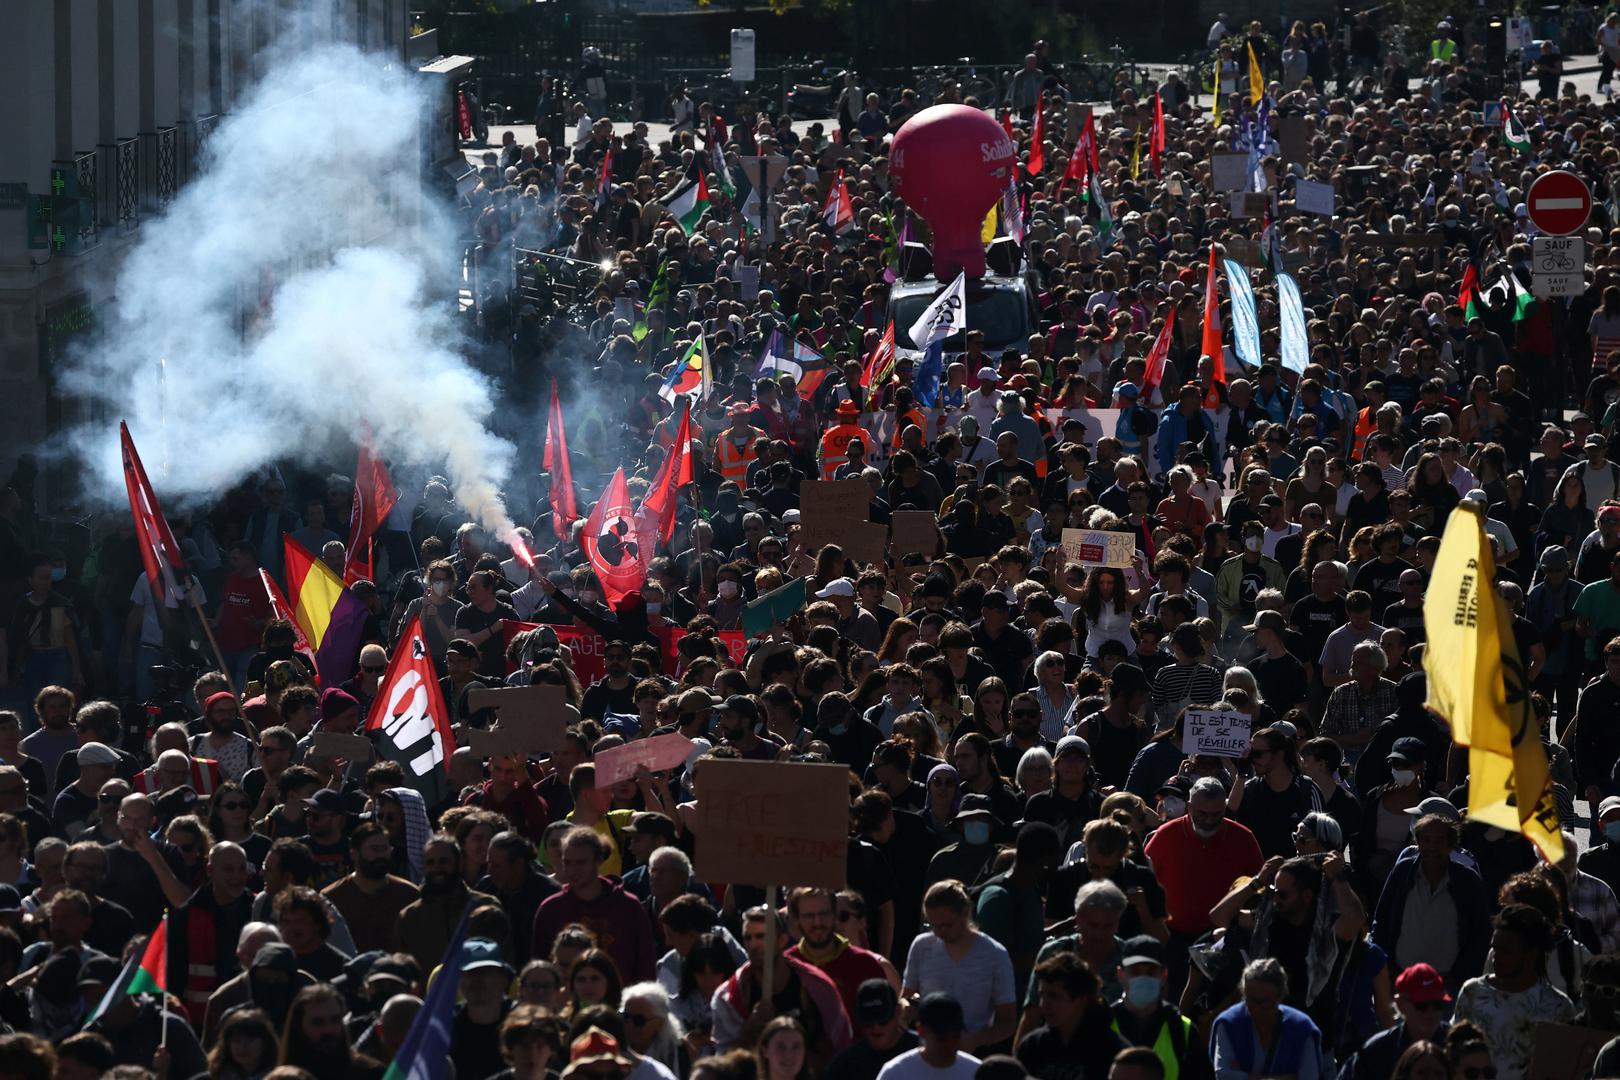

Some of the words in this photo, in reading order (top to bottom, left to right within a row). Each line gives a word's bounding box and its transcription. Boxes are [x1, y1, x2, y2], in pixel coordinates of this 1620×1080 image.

[1545, 240, 1572, 249] SAUF
[377, 669, 444, 777] CNT
[1189, 714, 1206, 726] IL
[1208, 714, 1227, 726] EST
[1229, 717, 1251, 729] TEMPS
[1192, 727, 1205, 736] DE
[1215, 728, 1230, 736] SE
[704, 789, 784, 830] FREE
